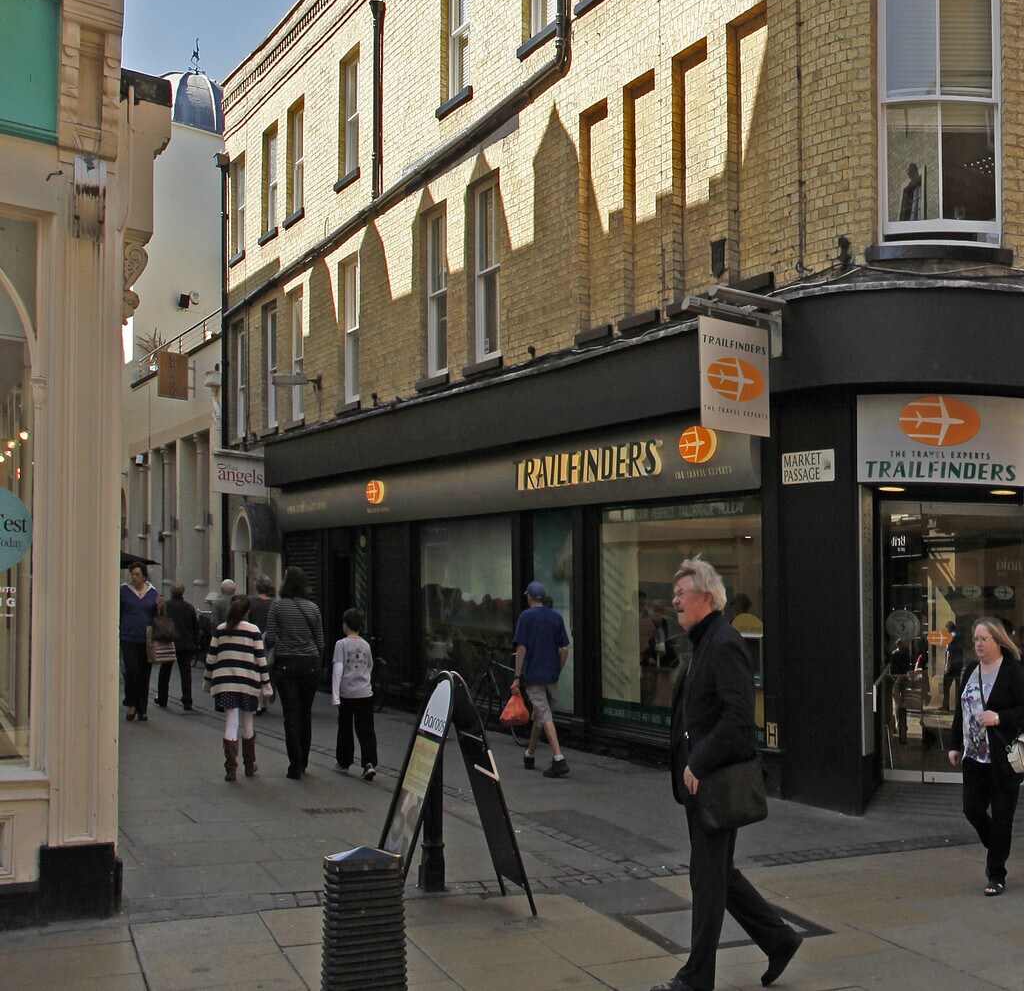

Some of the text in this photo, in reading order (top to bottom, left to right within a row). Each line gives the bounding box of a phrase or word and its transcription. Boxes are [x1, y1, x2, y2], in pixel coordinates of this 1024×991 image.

[702, 334, 767, 356] TRAILFINDERS
[704, 404, 768, 420] THE TRAVEL EXPERTS
[783, 452, 822, 468] MARKET
[890, 450, 906, 458] THE
[950, 451, 991, 460] EXPERTS
[513, 439, 662, 490] TRAILFINDERS
[865, 460, 1017, 482] TRAILFINDERS
[218, 469, 264, 487] angels
[783, 467, 821, 483] PASSAGE
[768, 723, 778, 747] H
